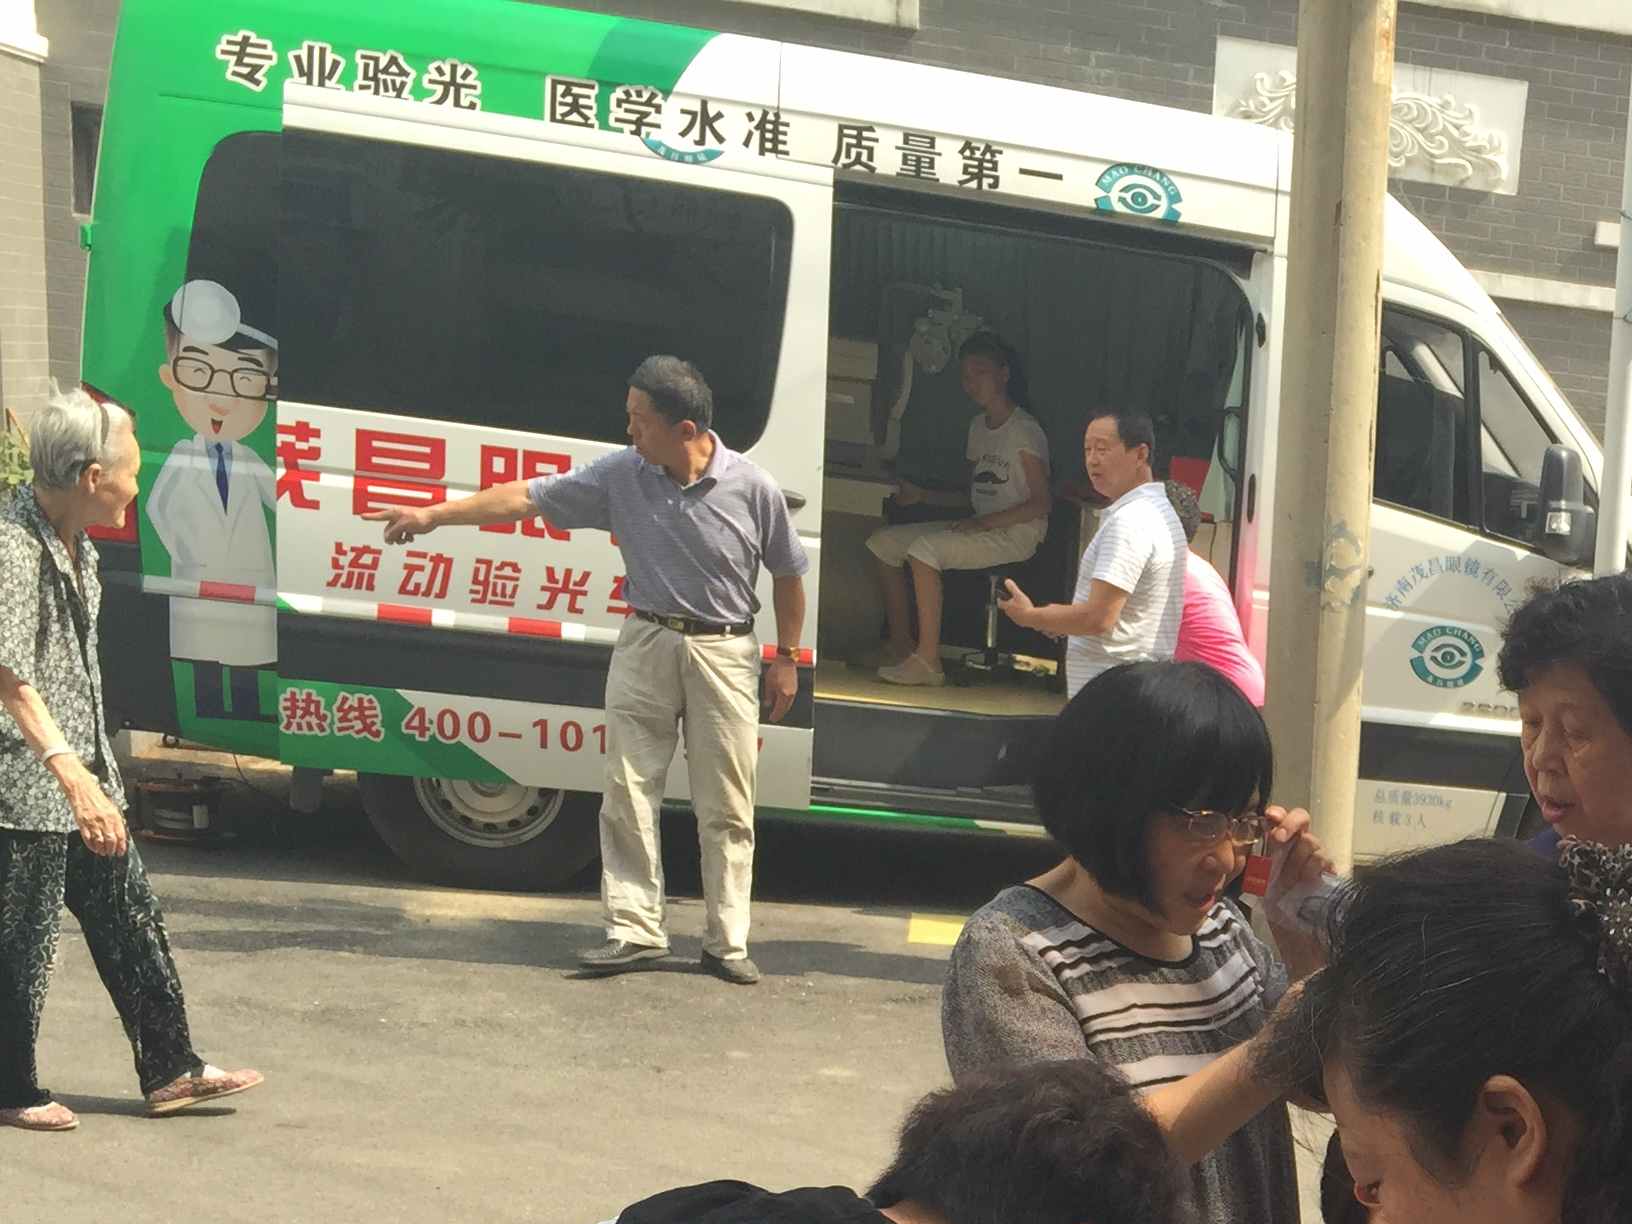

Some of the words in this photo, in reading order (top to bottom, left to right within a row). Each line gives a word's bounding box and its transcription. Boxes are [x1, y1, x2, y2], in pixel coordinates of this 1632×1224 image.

[220, 34, 479, 111] 专业验光
[549, 79, 790, 157] 医学水准
[832, 123, 1064, 191] 质量第一
[282, 690, 385, 740] 热线
